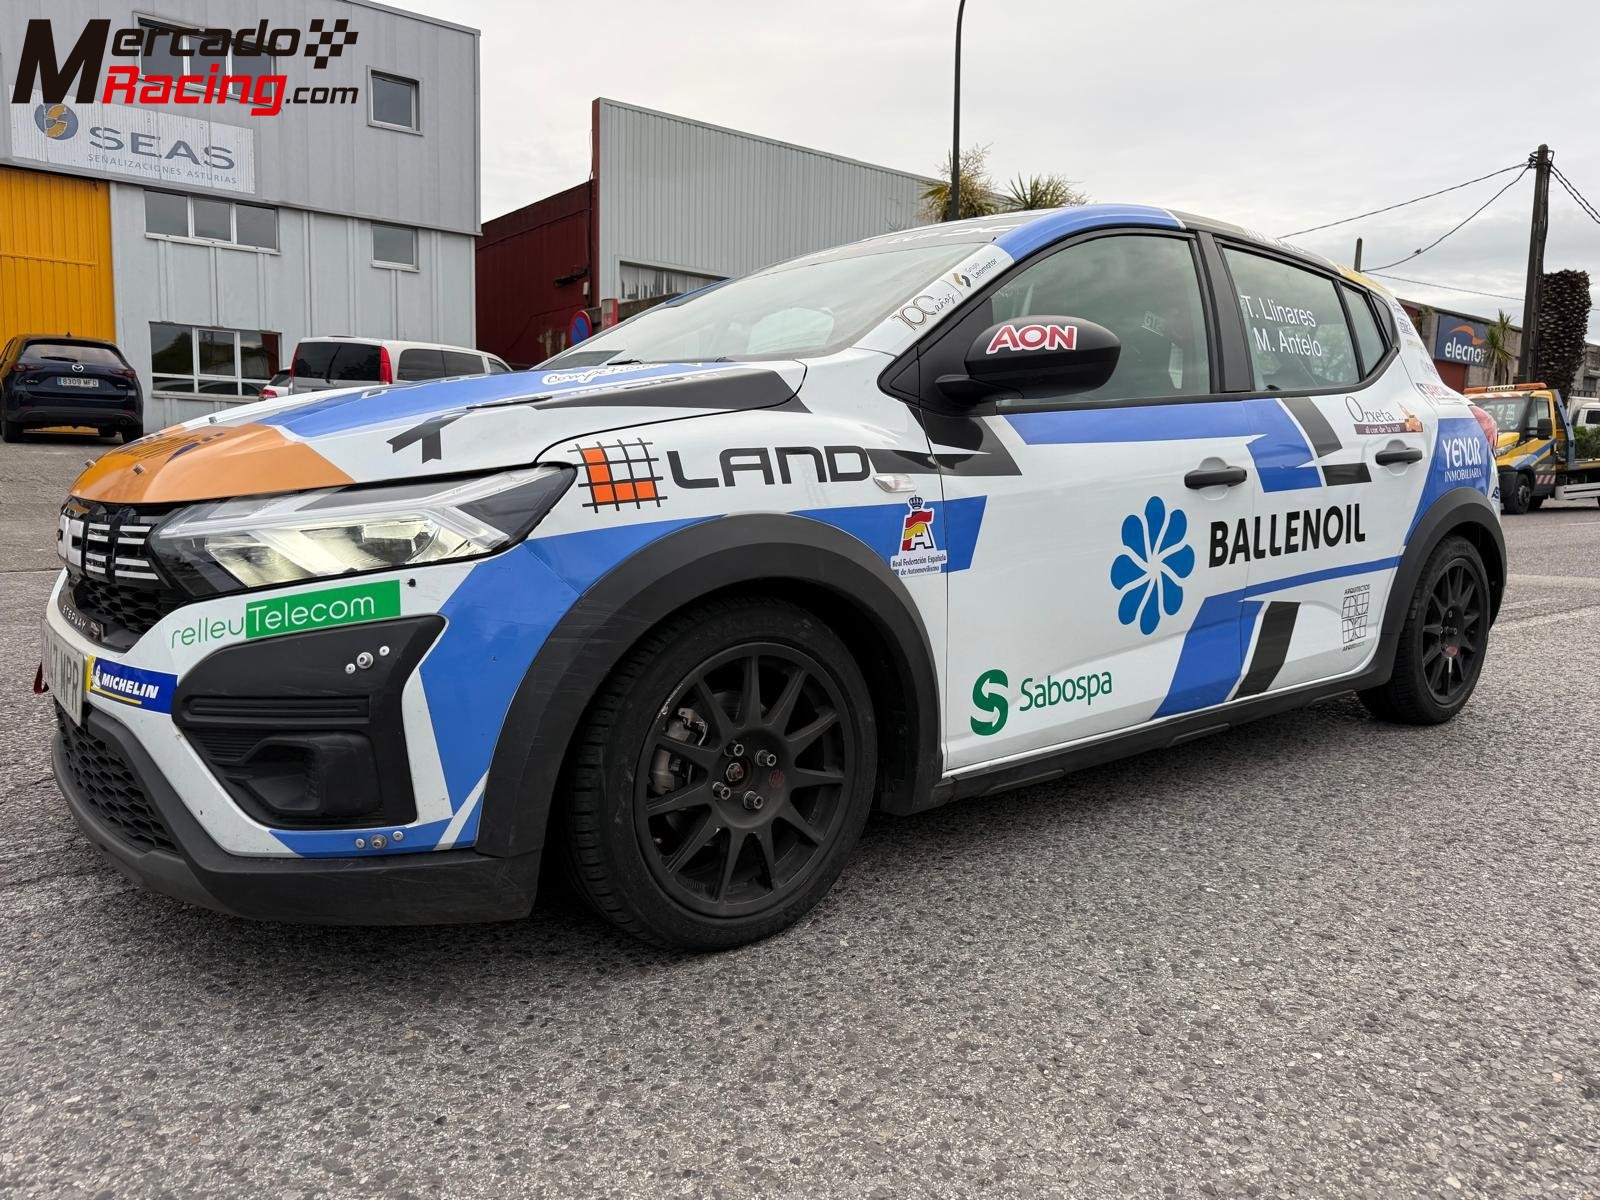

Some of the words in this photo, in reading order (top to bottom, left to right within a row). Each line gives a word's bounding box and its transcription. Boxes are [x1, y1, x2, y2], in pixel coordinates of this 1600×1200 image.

[90, 127, 235, 170] SEAS
[187, 170, 238, 184] ASTURIAS
[971, 258, 997, 279] Leomotor
[1241, 295, 1260, 319] T.
[1259, 297, 1317, 328] Llinares
[988, 325, 1077, 353] AON
[1253, 327, 1276, 352] M.
[1279, 331, 1322, 357] Antelo
[667, 446, 871, 489] LAND
[1442, 437, 1482, 469] YENAR
[1444, 468, 1482, 483] INMOBILIARIA
[1209, 503, 1366, 568] BALLENOIL
[892, 559, 902, 567] Real
[62, 604, 86, 630] STEPWAY
[101, 673, 160, 699] MICHELIN
[1019, 671, 1112, 711] Sabospa
